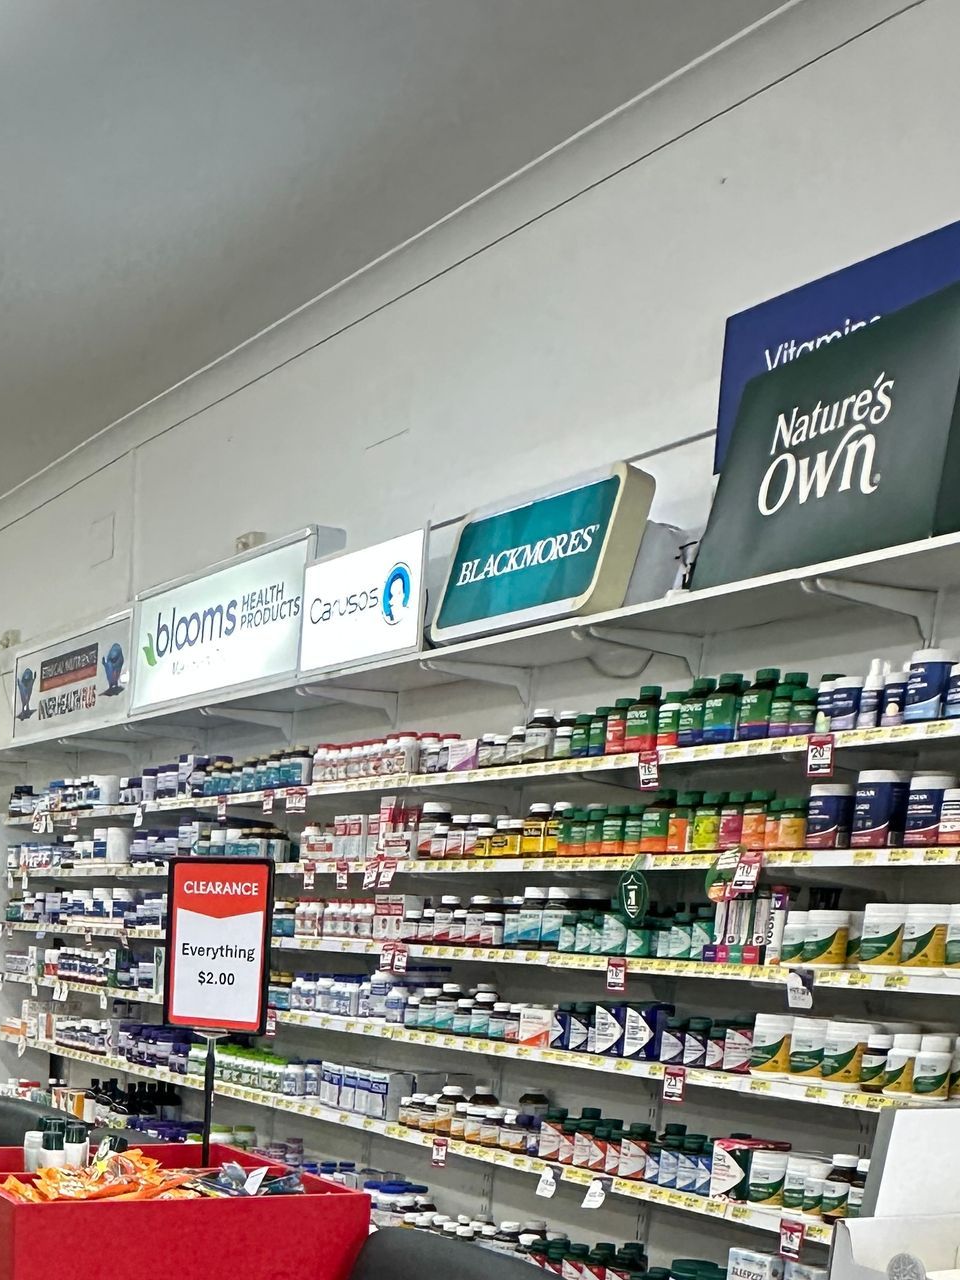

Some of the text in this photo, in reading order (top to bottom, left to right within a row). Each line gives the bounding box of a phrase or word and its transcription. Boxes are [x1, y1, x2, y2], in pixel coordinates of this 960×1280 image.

[770, 371, 894, 455] Nature's
[758, 424, 877, 516] Own
[456, 526, 594, 586] BLACKMORES
[240, 596, 300, 630] PRODUCTS
[241, 582, 284, 612] HEALTH
[156, 599, 237, 658] blooms
[183, 881, 259, 896] CLEARANCE
[182, 943, 255, 962] Everything
[198, 971, 235, 986] $2.00
